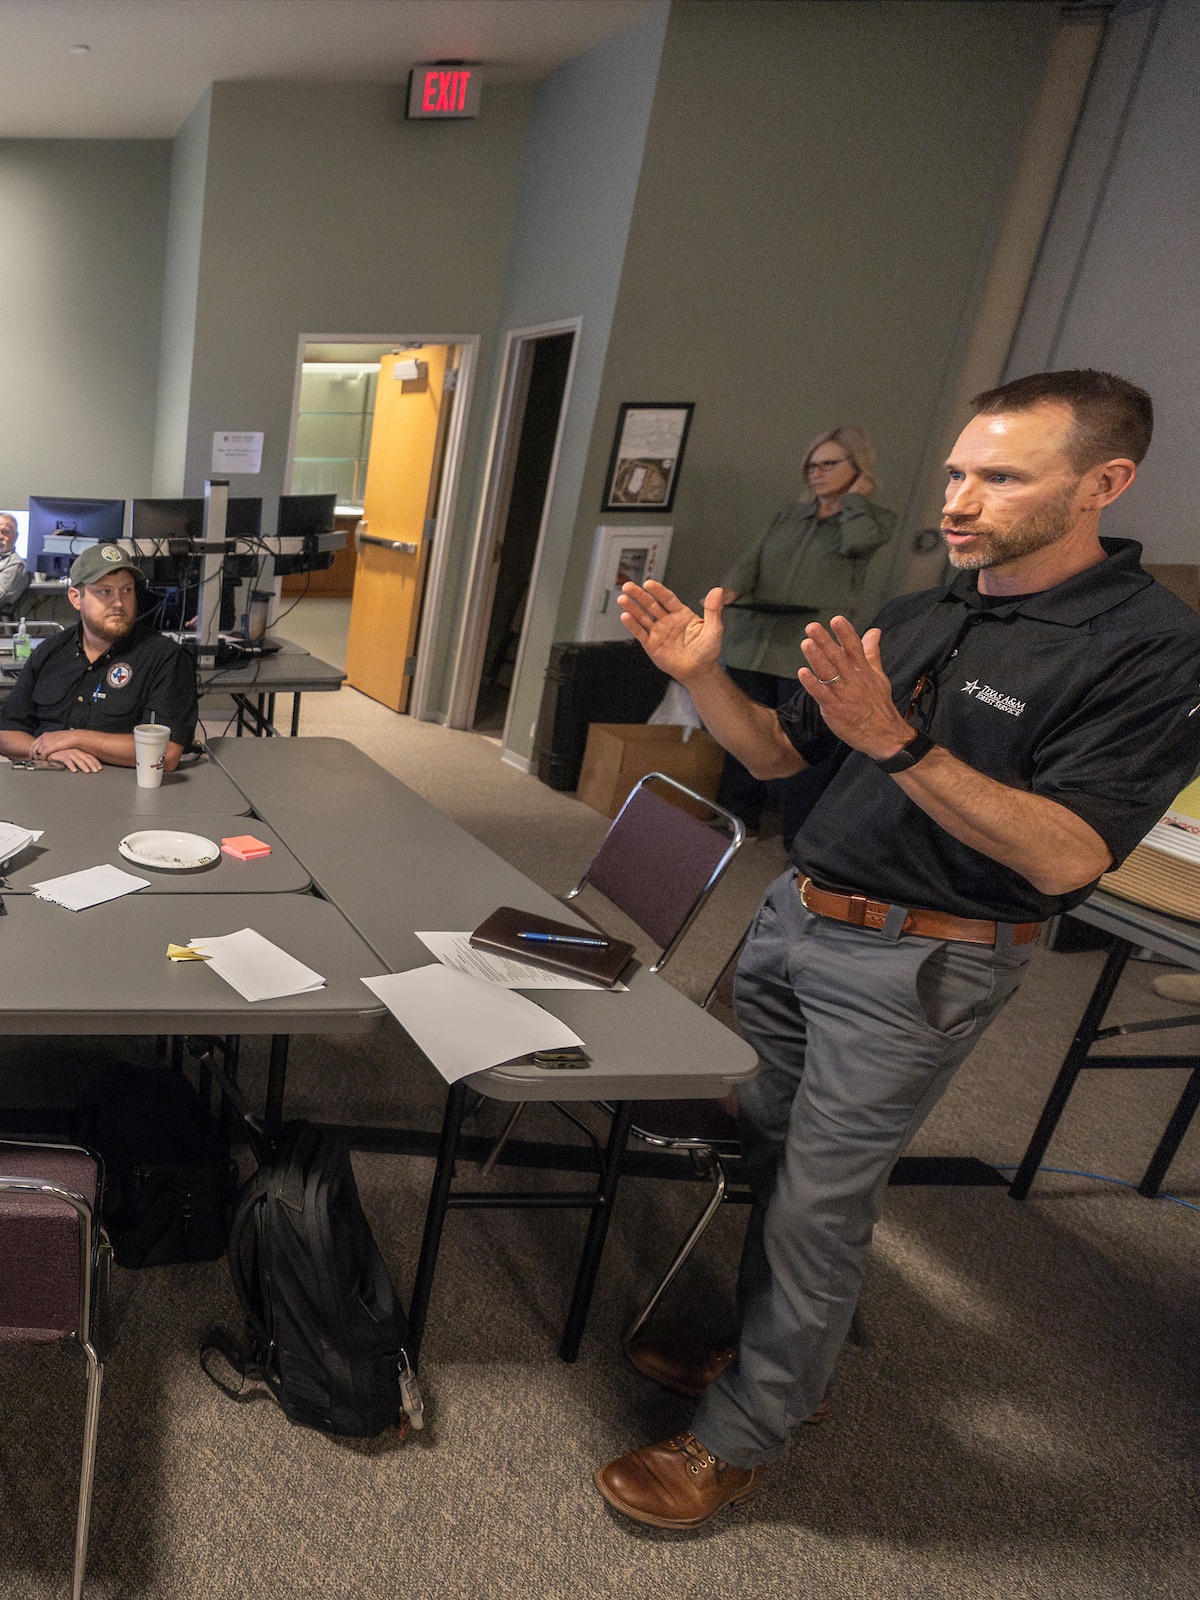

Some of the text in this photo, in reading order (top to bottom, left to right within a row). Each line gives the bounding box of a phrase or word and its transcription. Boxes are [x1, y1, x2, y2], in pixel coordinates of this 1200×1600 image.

[422, 71, 471, 112] EXIT
[975, 691, 1021, 717] FOREST SERVICE
[981, 684, 1026, 712] TEXAS A&M
